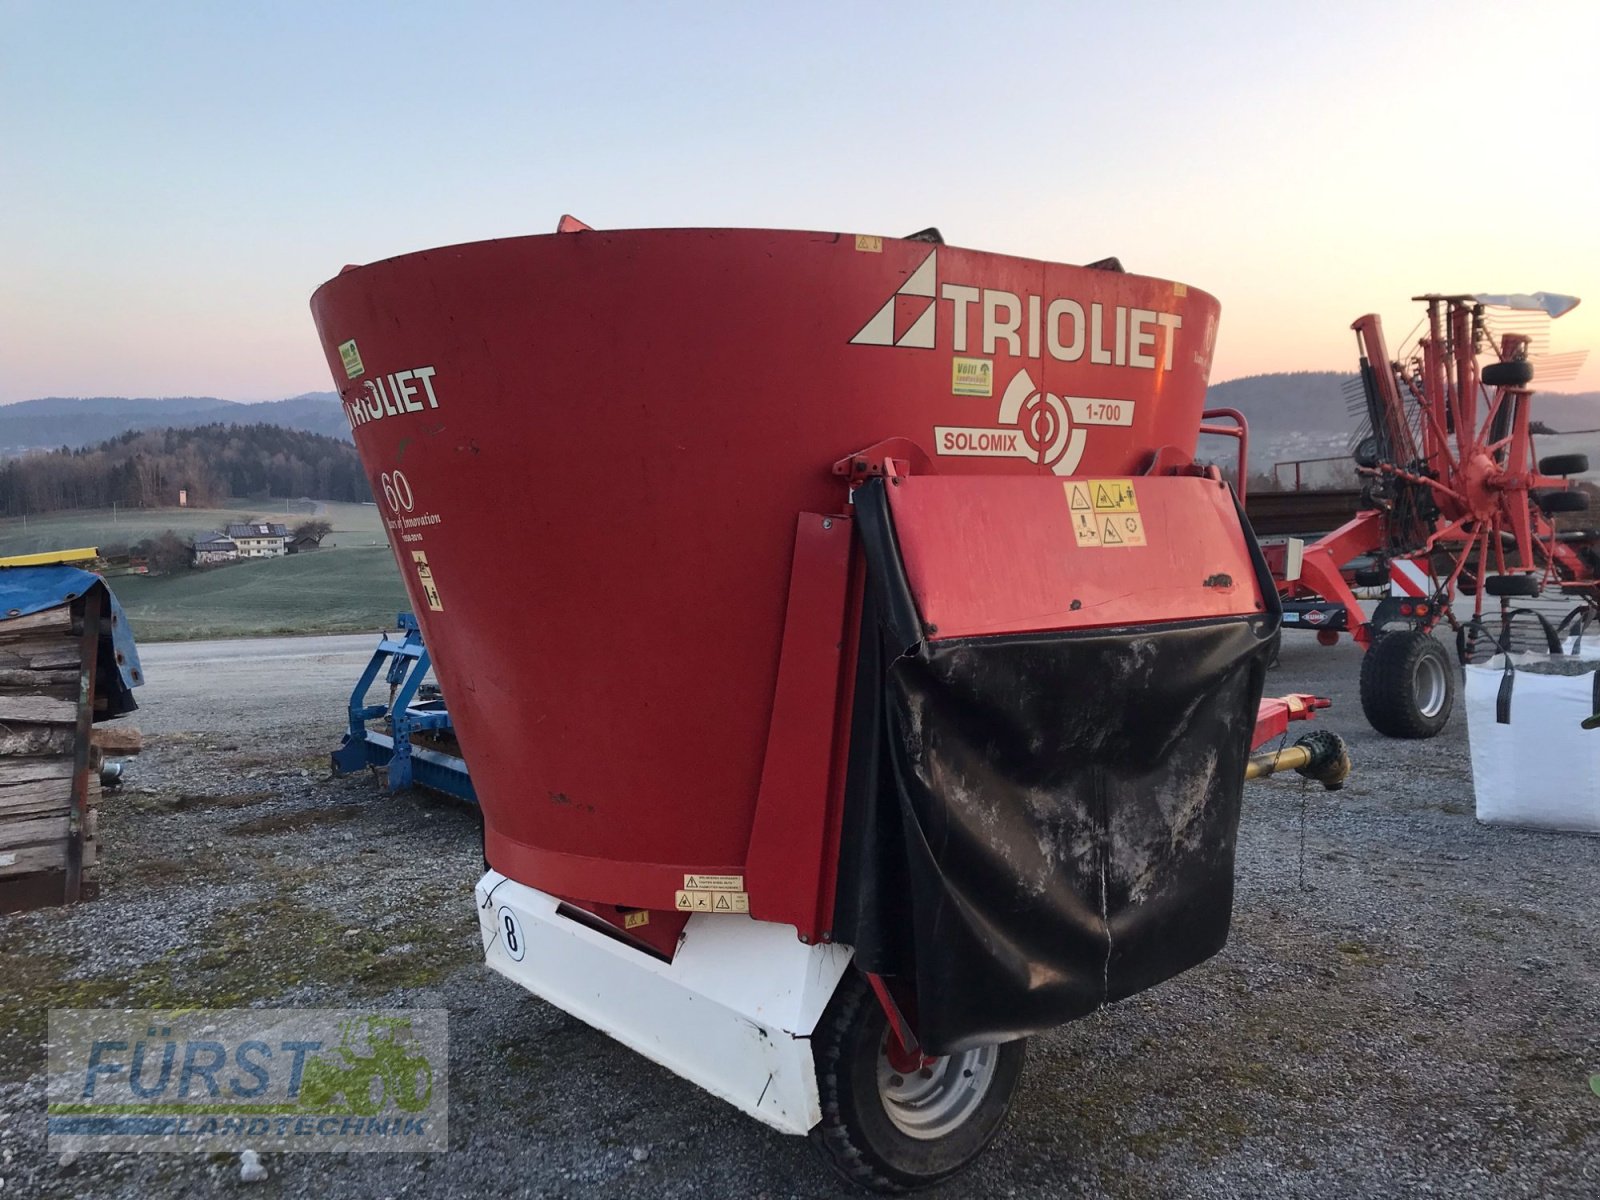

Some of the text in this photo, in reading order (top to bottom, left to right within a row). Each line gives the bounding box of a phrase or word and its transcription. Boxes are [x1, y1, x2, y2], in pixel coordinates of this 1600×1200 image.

[942, 282, 1182, 371] TRIOLIET
[1086, 403, 1121, 421] 1-700
[943, 432, 1018, 452] SOLOMIX
[381, 469, 414, 514] 60
[402, 512, 441, 529] Innovation
[504, 915, 518, 952] 8
